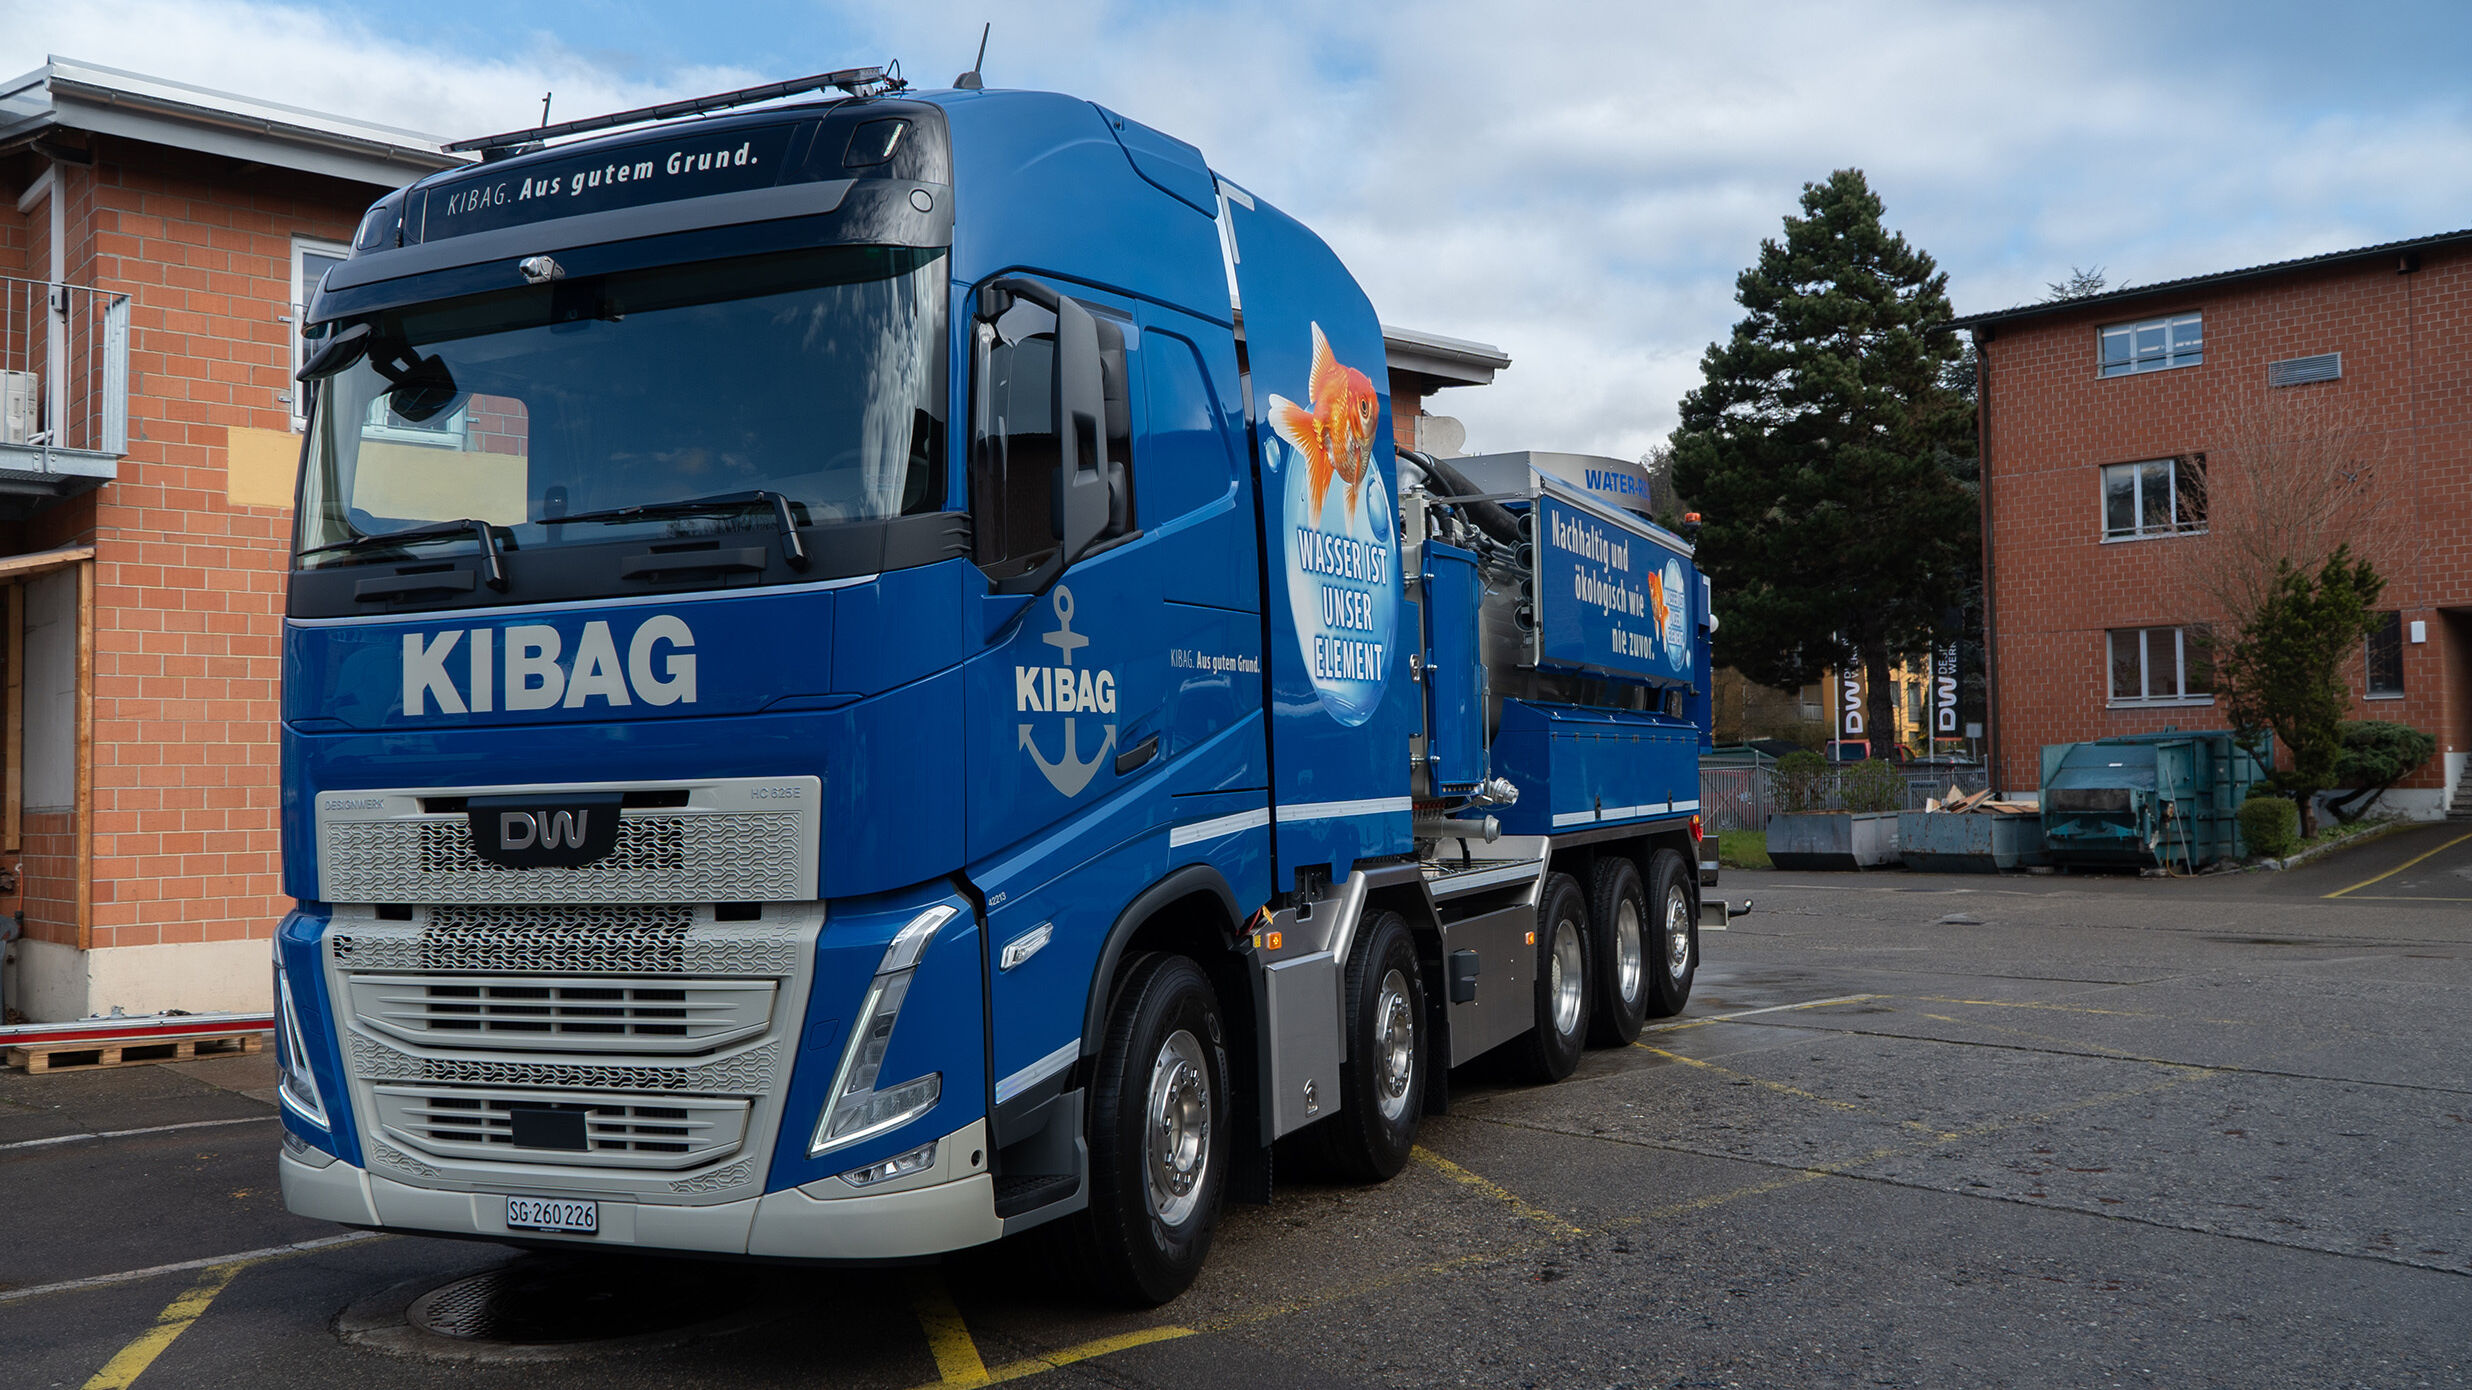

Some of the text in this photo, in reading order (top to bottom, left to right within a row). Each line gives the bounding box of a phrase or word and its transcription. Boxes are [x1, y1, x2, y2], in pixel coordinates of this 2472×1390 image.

[447, 142, 758, 216] KIBAG. Aus gutem Grund.
[1297, 529, 1387, 585] WASSER IST
[1552, 509, 1629, 574] Nachhaltig und
[1322, 586, 1373, 631] UNSER
[1575, 564, 1644, 618] ökologisch wie
[403, 614, 697, 716] KIBAG
[1171, 648, 1260, 675] KIBAG. Aus gutem Grund.
[1315, 637, 1383, 681] ELEMENT
[1612, 620, 1655, 660] nie zuvor.
[1015, 666, 1116, 714] KIBAG
[1844, 680, 1864, 734] DW
[1937, 676, 1958, 731] DW
[324, 799, 385, 811] DESIGNWERK
[501, 809, 588, 850] DW
